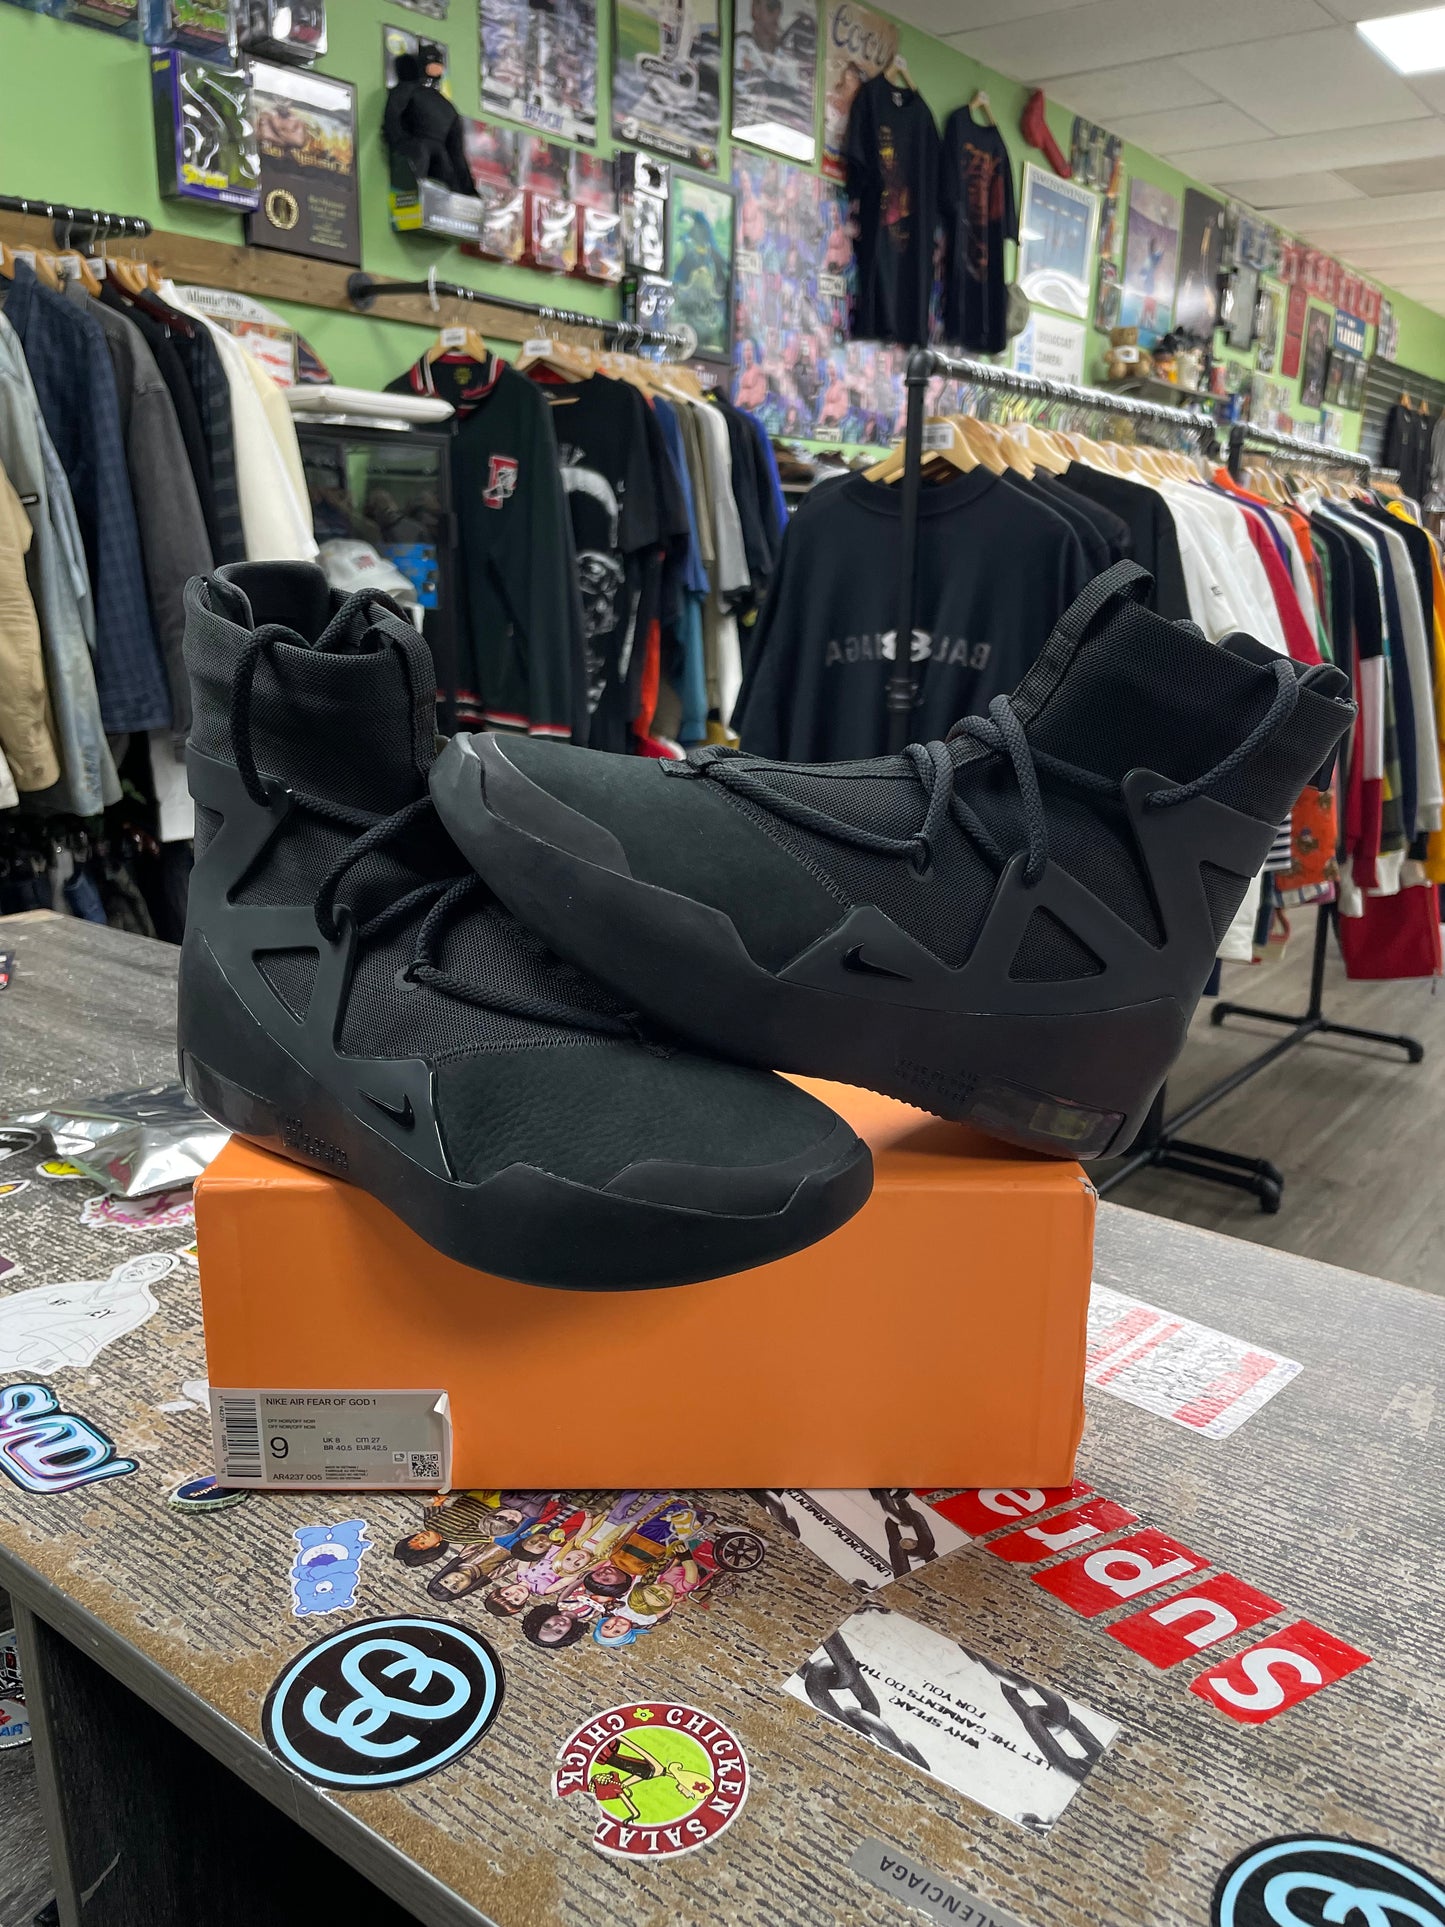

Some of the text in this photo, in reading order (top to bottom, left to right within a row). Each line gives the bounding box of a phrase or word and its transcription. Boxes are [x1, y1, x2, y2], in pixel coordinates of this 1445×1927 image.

[266, 1398, 287, 1406] NIKE
[289, 1398, 304, 1406] AIR
[307, 1398, 331, 1406] FEAR
[270, 1436, 289, 1459] 9
[885, 1677, 907, 1692] DO
[923, 1679, 987, 1720] FOR YOU.
[889, 1695, 980, 1749] WHY SPEAK?
[906, 1689, 987, 1735] GARMENTS
[988, 1732, 1018, 1753] THE
[558, 1708, 742, 1851] CHICKEN SALAD CHICK
